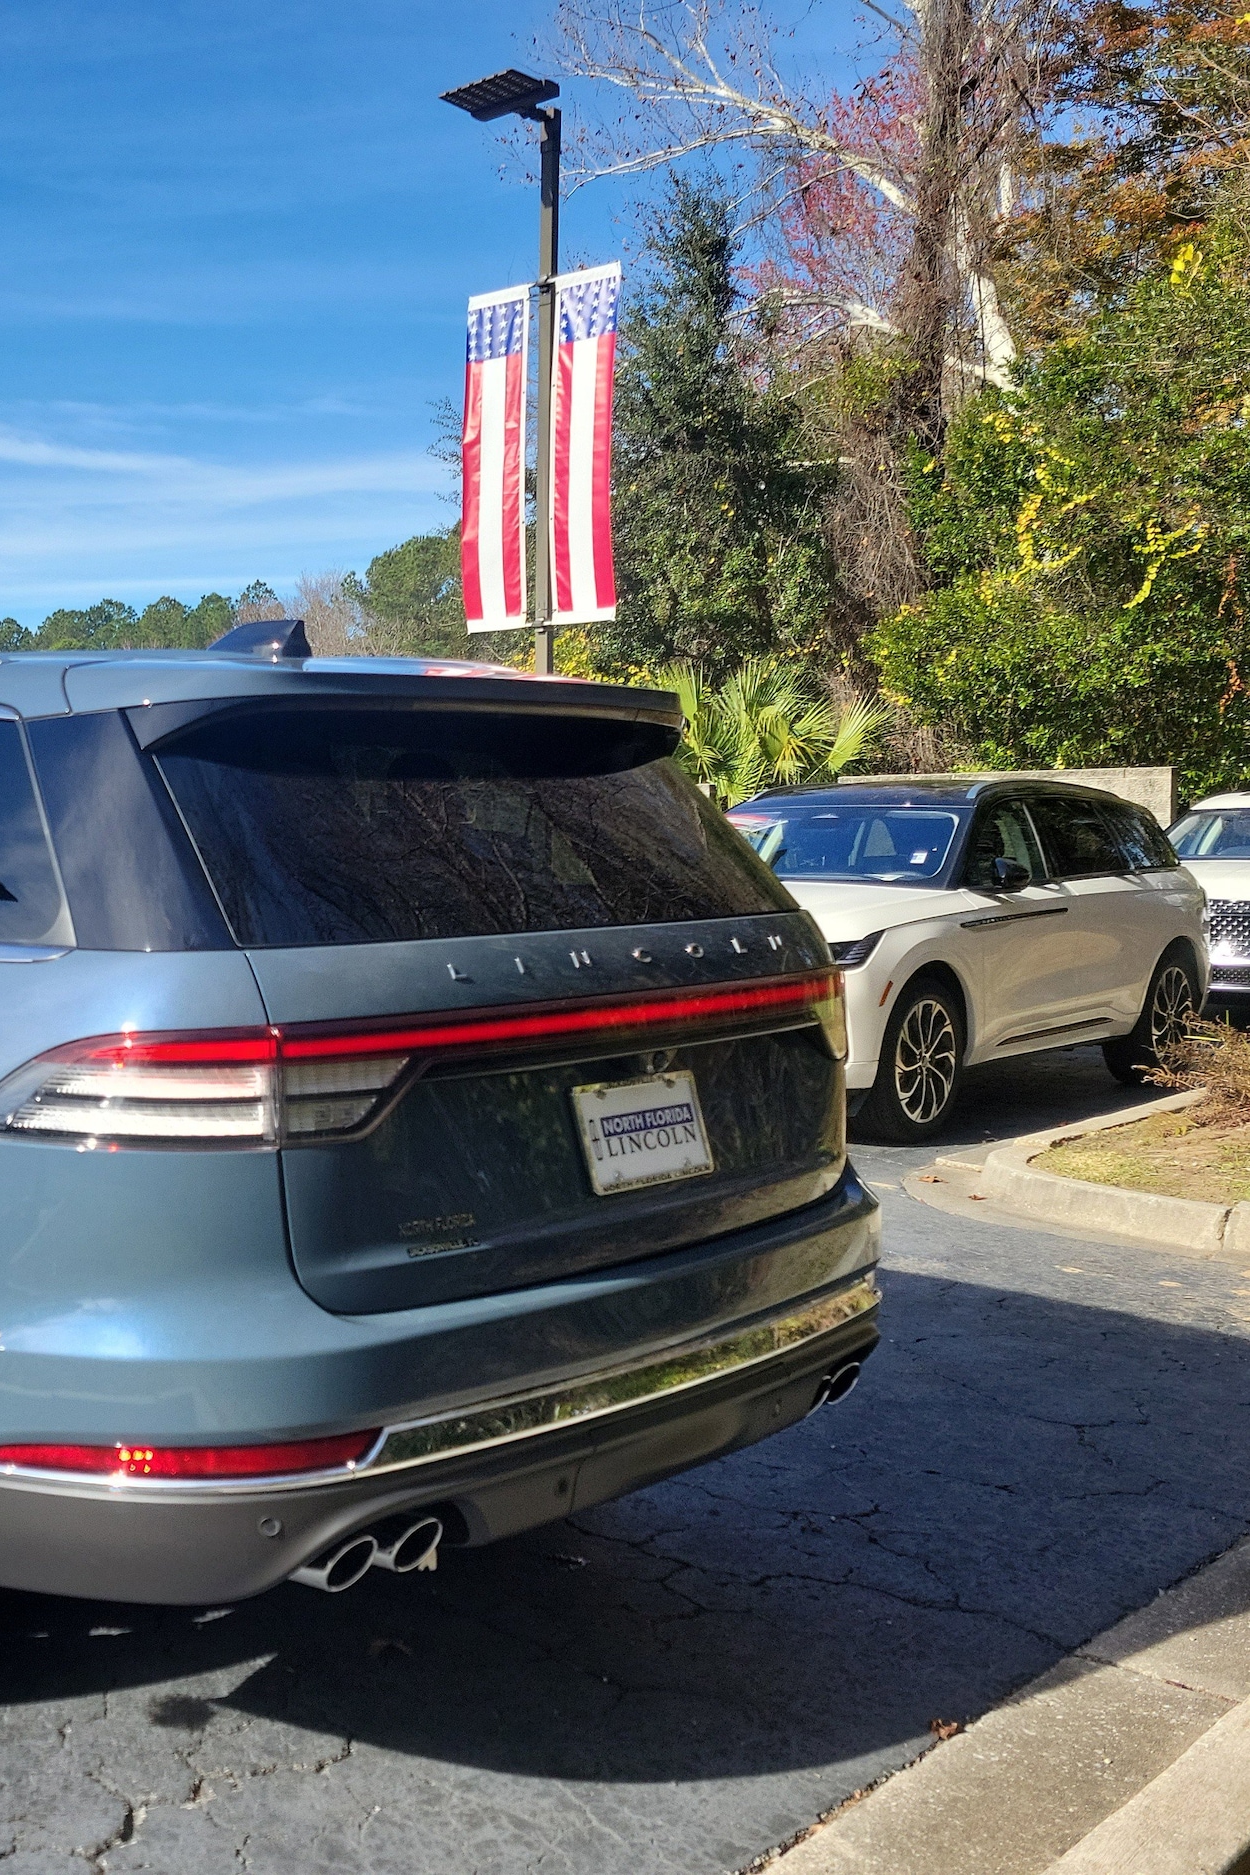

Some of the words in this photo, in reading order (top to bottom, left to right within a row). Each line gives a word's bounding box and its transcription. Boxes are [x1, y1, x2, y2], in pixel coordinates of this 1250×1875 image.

[446, 933, 784, 981] LINCOLN
[602, 1114, 645, 1135] NORTH
[646, 1106, 692, 1128] FLORIDA
[605, 1123, 698, 1158] LINCOLN
